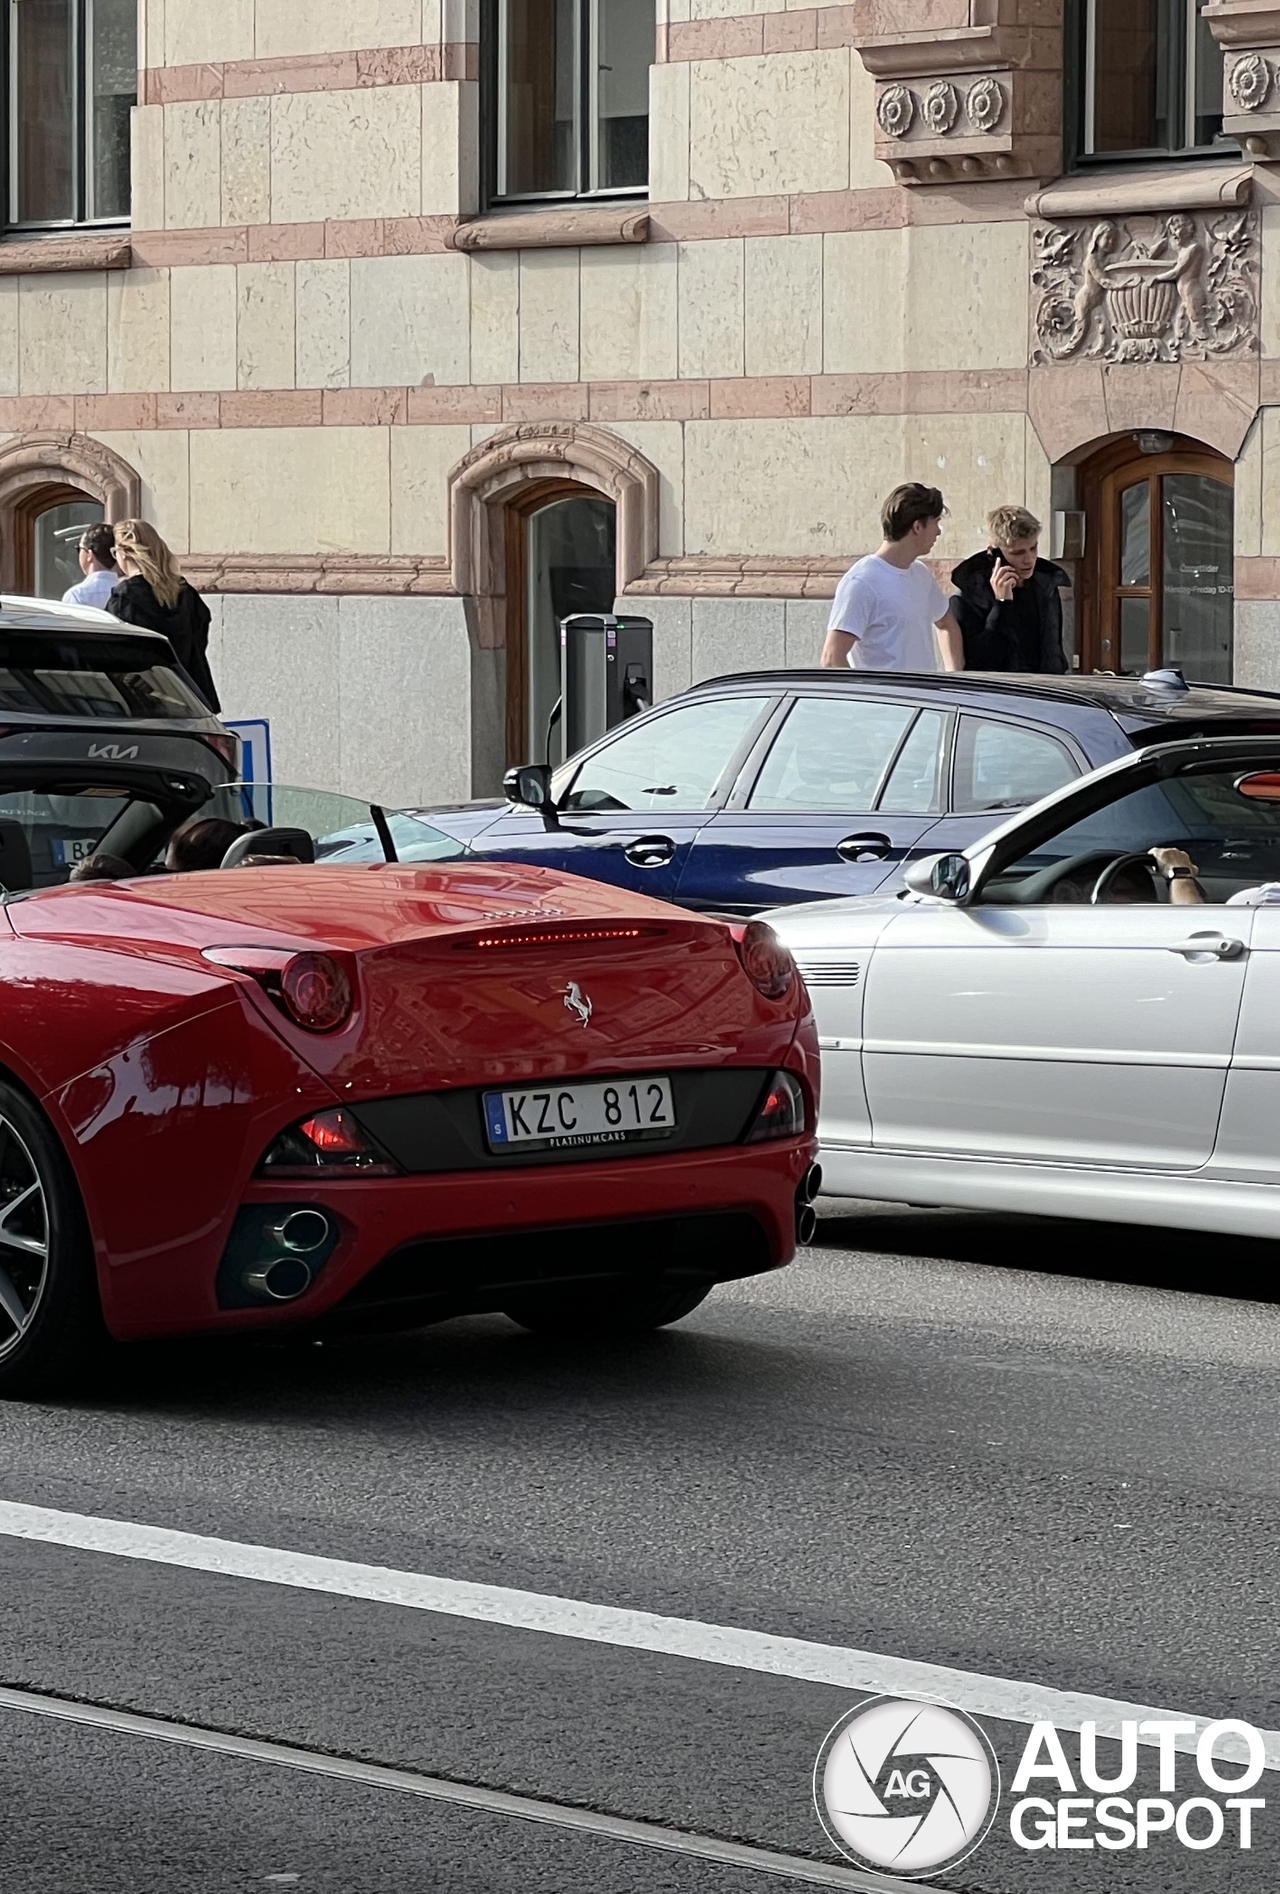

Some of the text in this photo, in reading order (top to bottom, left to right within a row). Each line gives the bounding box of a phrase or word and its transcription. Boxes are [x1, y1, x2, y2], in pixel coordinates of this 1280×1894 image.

[509, 1084, 667, 1136] KZC 812
[494, 1123, 502, 1135] S
[550, 1131, 627, 1147] PLATINUMCARS
